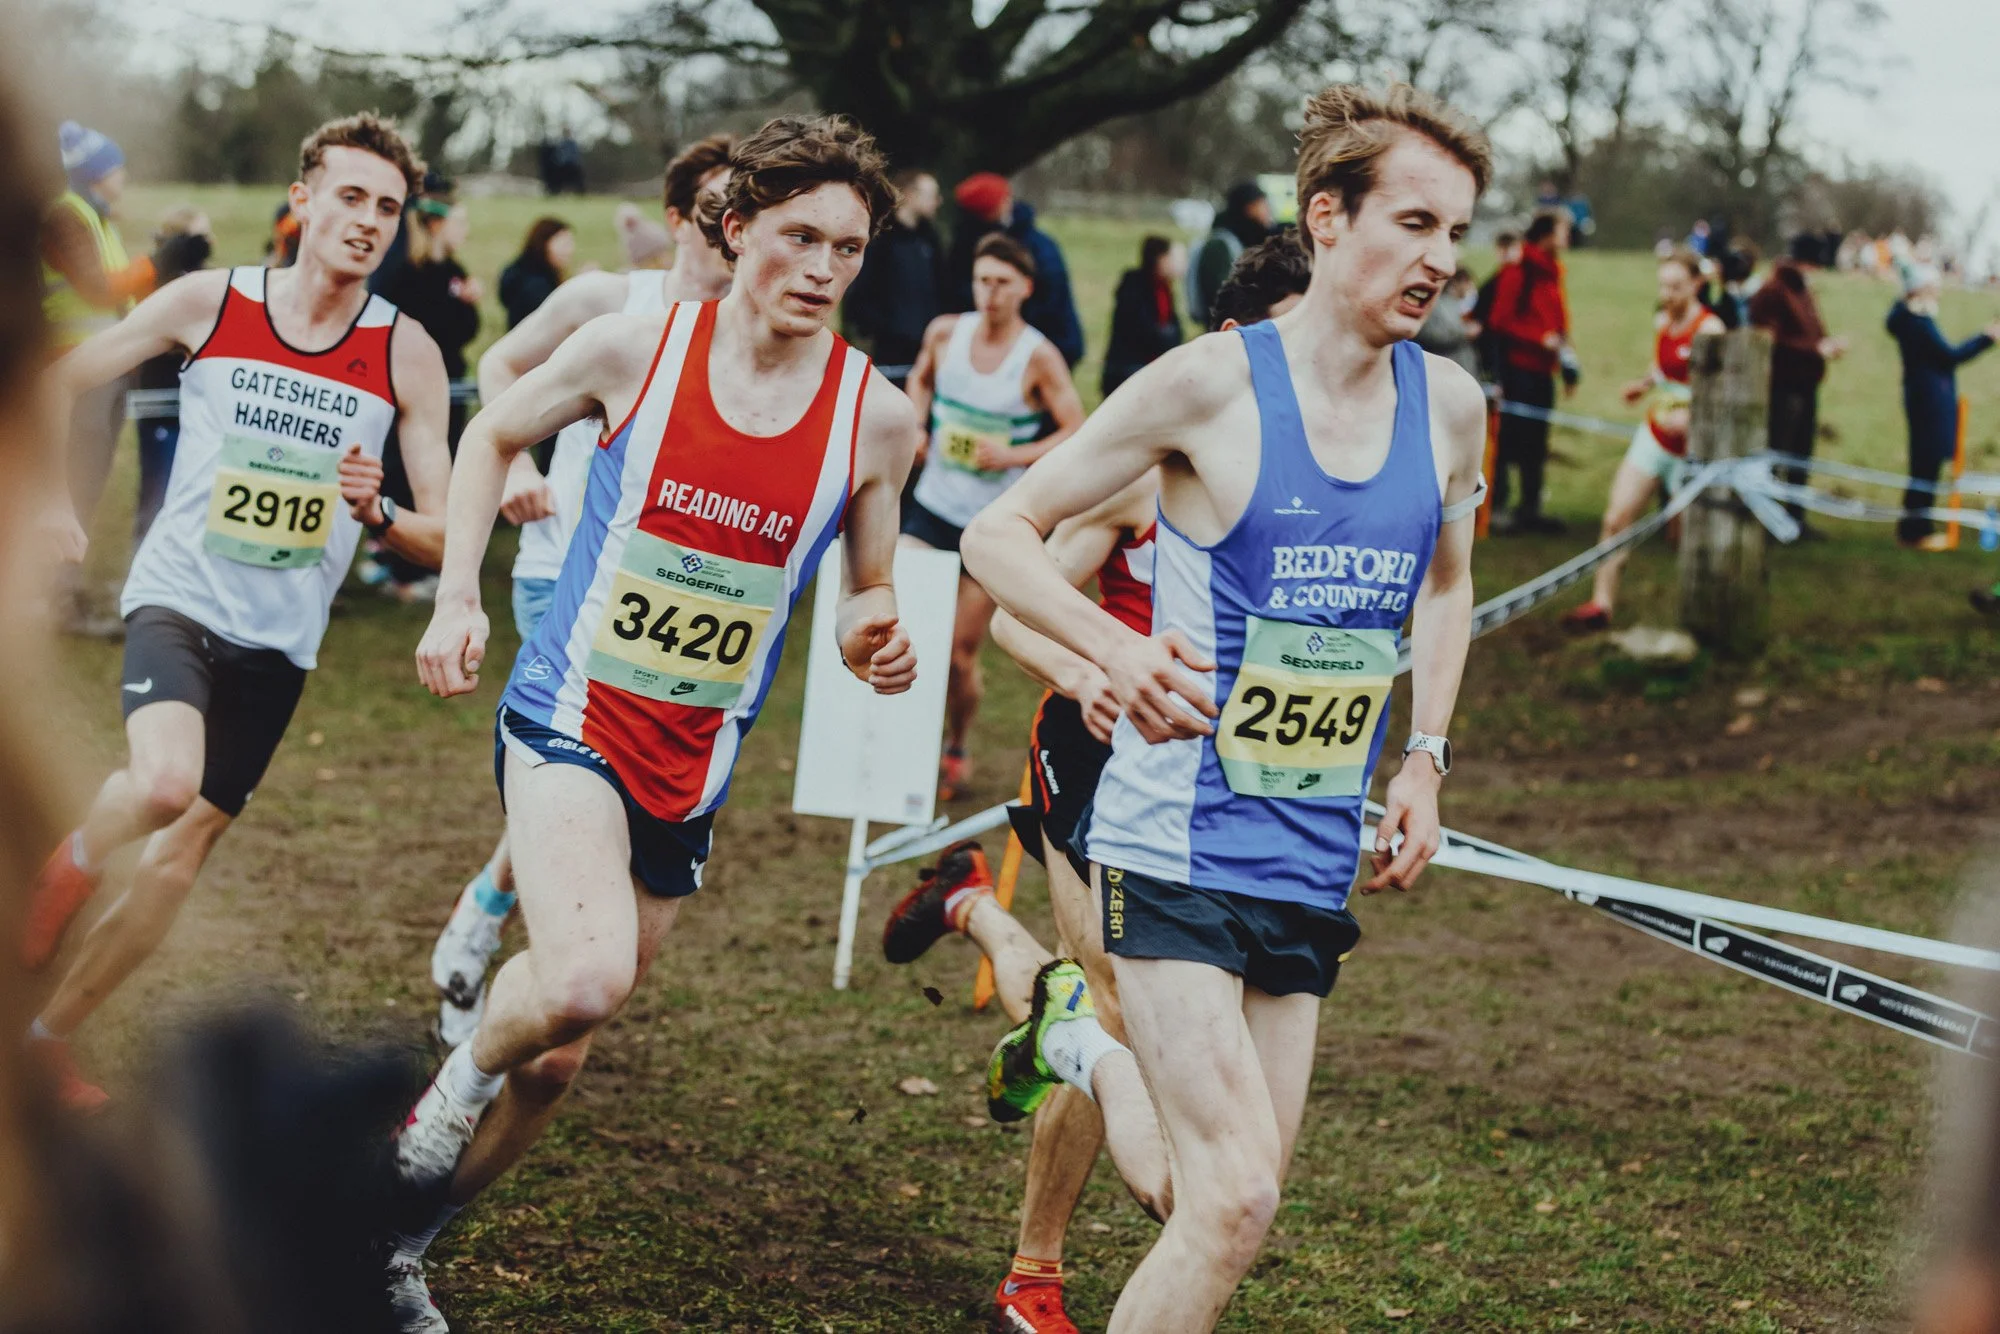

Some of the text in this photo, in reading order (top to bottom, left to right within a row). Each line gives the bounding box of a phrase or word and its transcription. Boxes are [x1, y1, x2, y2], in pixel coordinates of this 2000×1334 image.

[231, 367, 359, 417] GATESHEAD
[234, 402, 343, 448] HARRIERS
[223, 485, 325, 533] 2918
[657, 478, 793, 543] READING AC
[656, 567, 745, 598] SEDGEFIELD
[1271, 544, 1417, 585] BEDFORD
[1269, 586, 1289, 609] &
[613, 591, 753, 666] 3420
[1280, 654, 1364, 671] SEDGEFIELD
[1233, 686, 1371, 747] 2549
